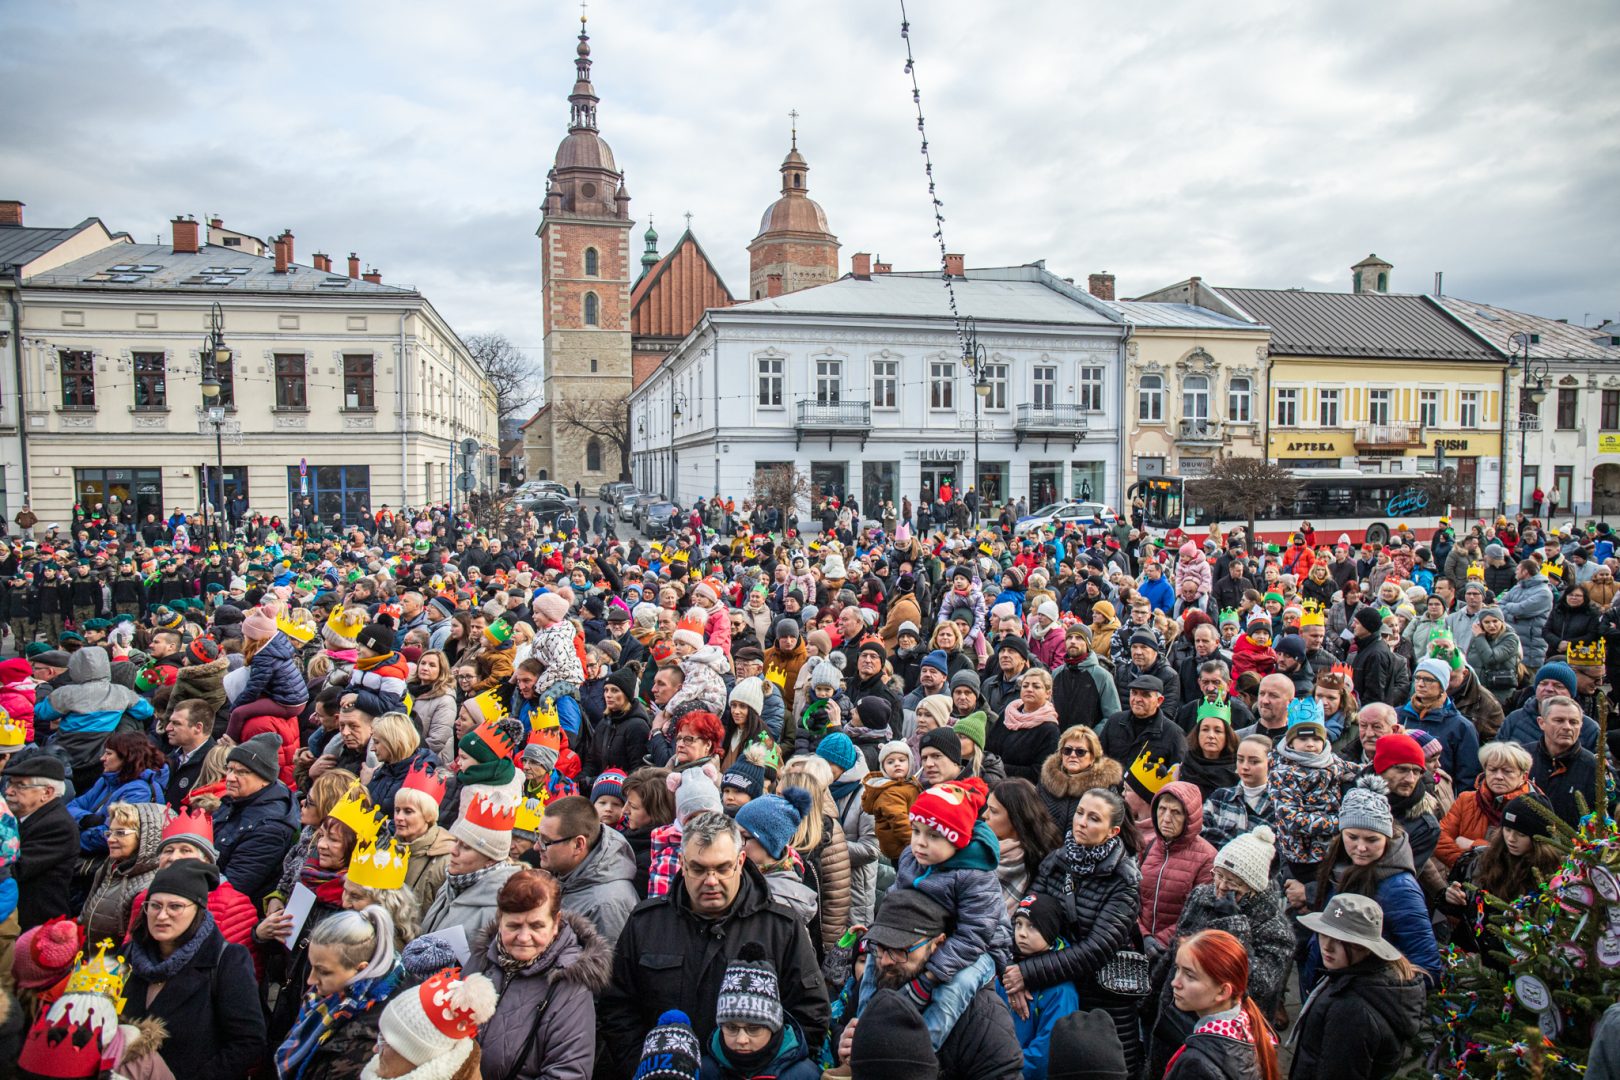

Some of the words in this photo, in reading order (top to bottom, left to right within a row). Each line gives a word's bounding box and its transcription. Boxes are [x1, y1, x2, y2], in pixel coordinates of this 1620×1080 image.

[1287, 443, 1335, 451] APTEKA
[1434, 439, 1468, 451] SUSHI
[926, 448, 954, 461] LIVE
